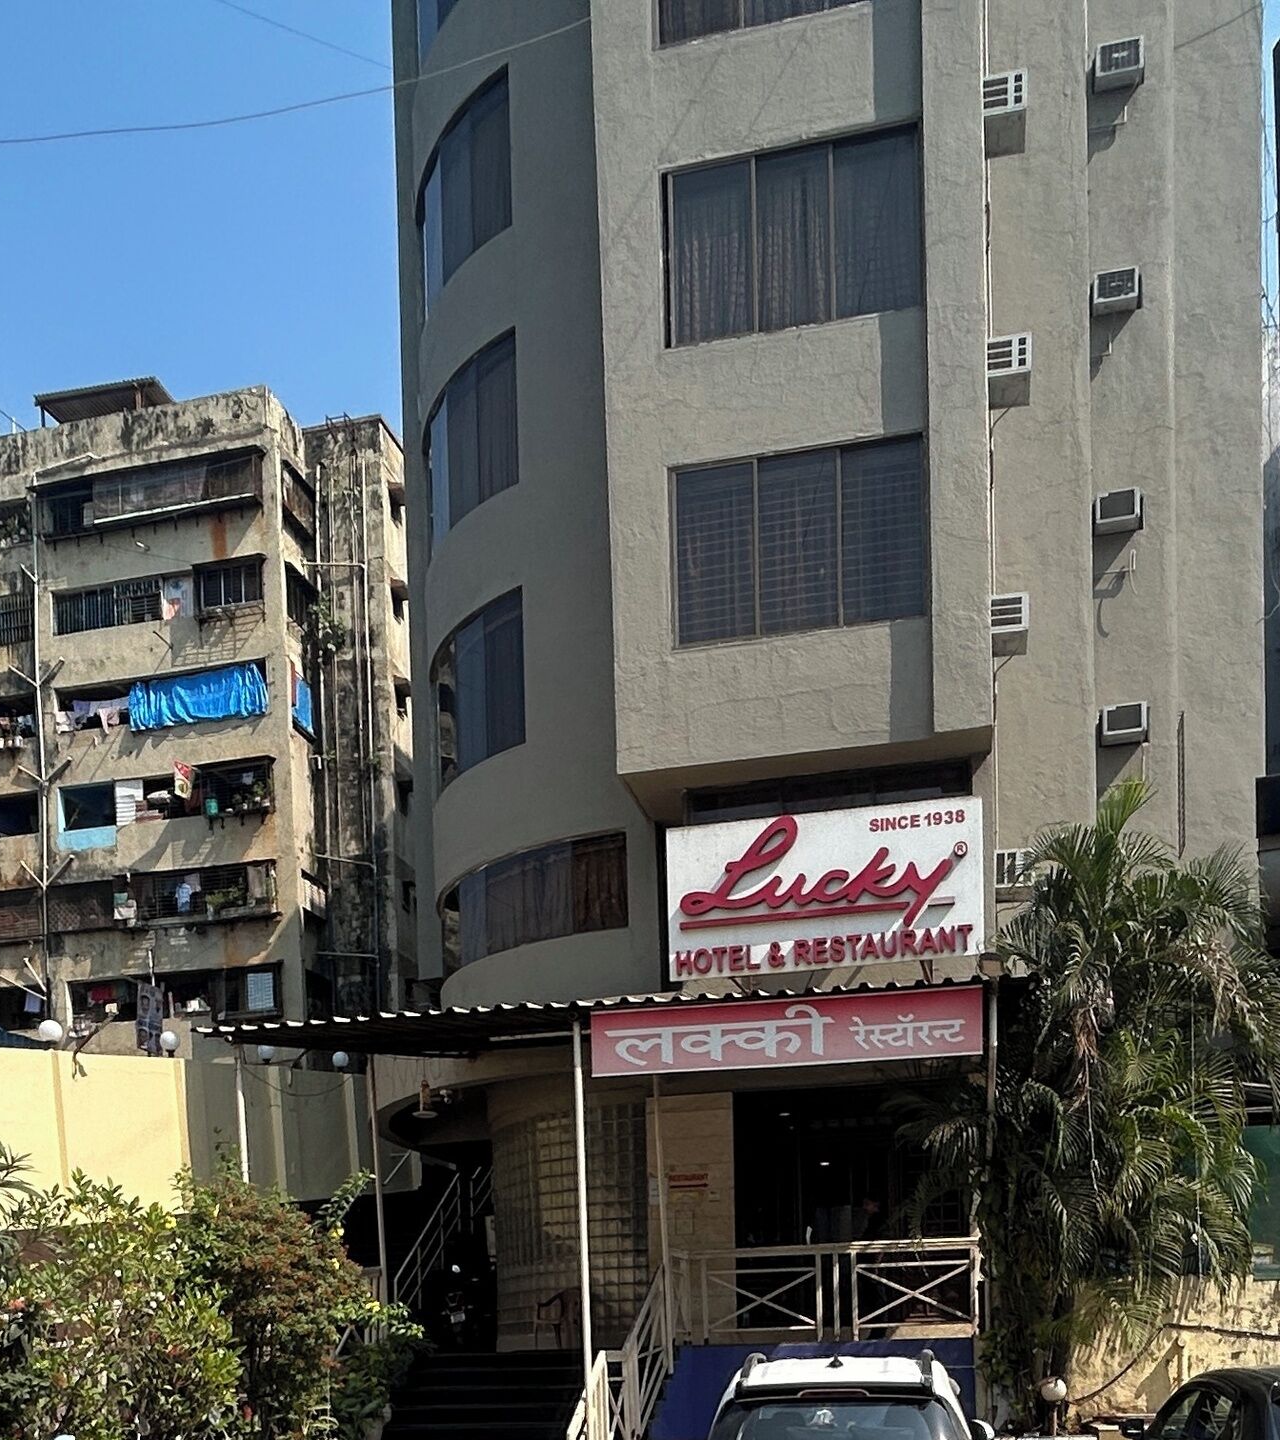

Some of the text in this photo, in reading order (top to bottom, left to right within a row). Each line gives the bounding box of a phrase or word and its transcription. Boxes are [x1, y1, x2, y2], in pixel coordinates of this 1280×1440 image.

[869, 809, 966, 832] SINCE 1938
[680, 815, 954, 928] Lucky
[675, 924, 974, 976] HOTEL & RESTAURANT
[605, 1003, 835, 1067] लक्की
